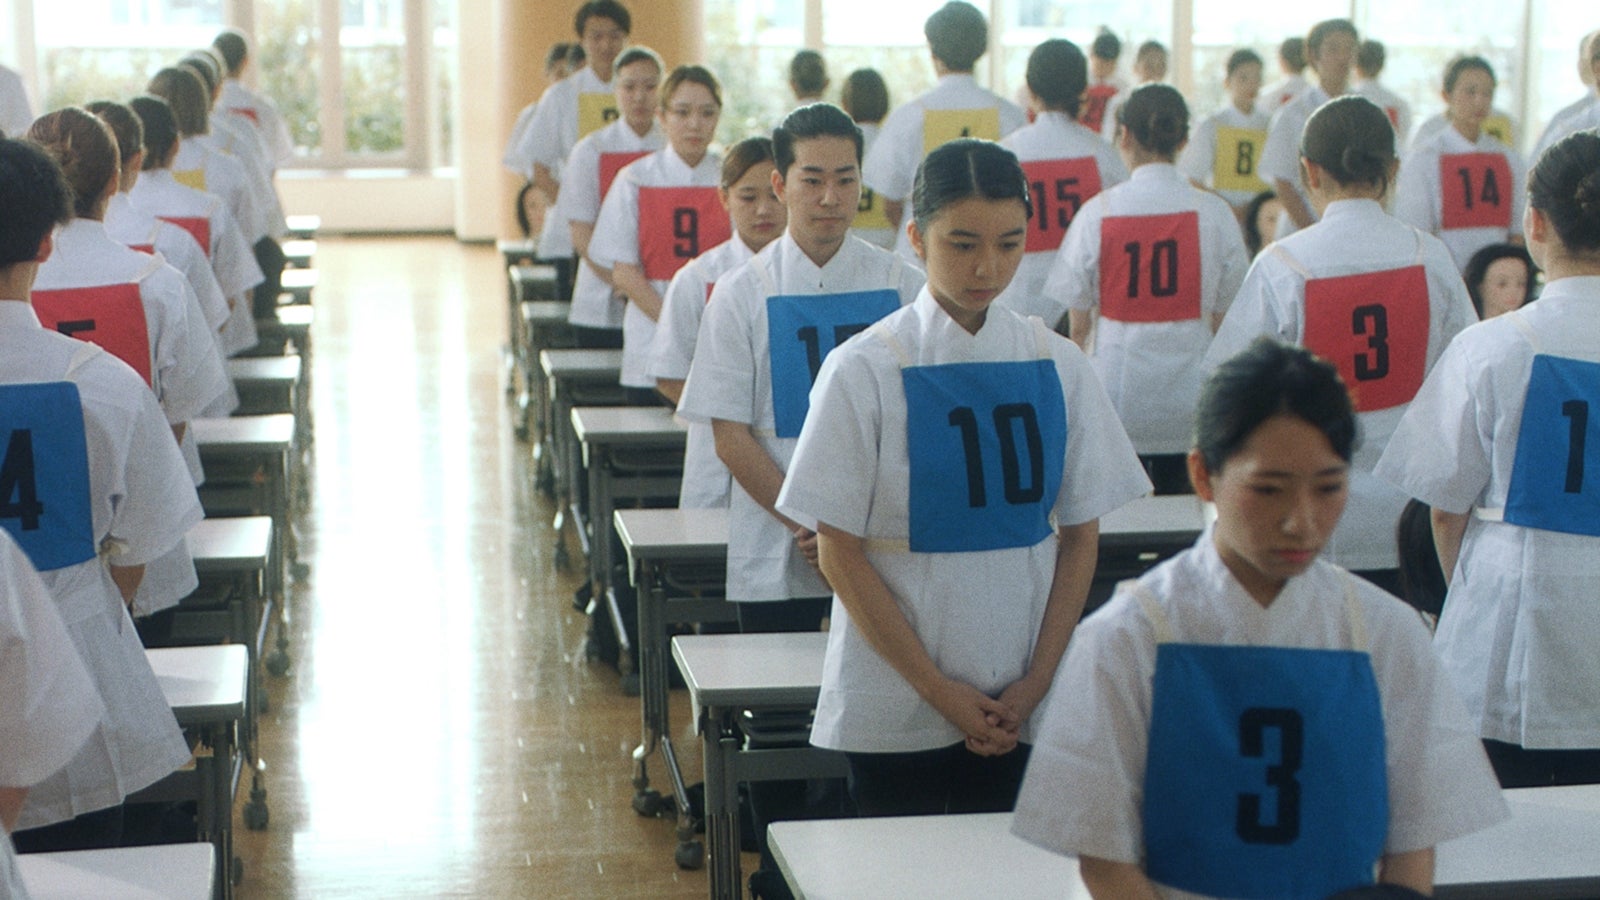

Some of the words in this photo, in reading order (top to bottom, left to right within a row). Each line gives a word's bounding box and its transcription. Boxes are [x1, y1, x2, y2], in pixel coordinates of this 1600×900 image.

[1237, 141, 1253, 175] 8
[1459, 167, 1500, 209] 14
[673, 207, 698, 257] 9
[1032, 178, 1082, 231] 15
[1125, 239, 1178, 298] 10
[797, 322, 870, 384] 1
[1351, 304, 1389, 381] 3
[0, 428, 44, 530] 4
[948, 403, 1044, 508] 10
[1238, 708, 1302, 844] 3
